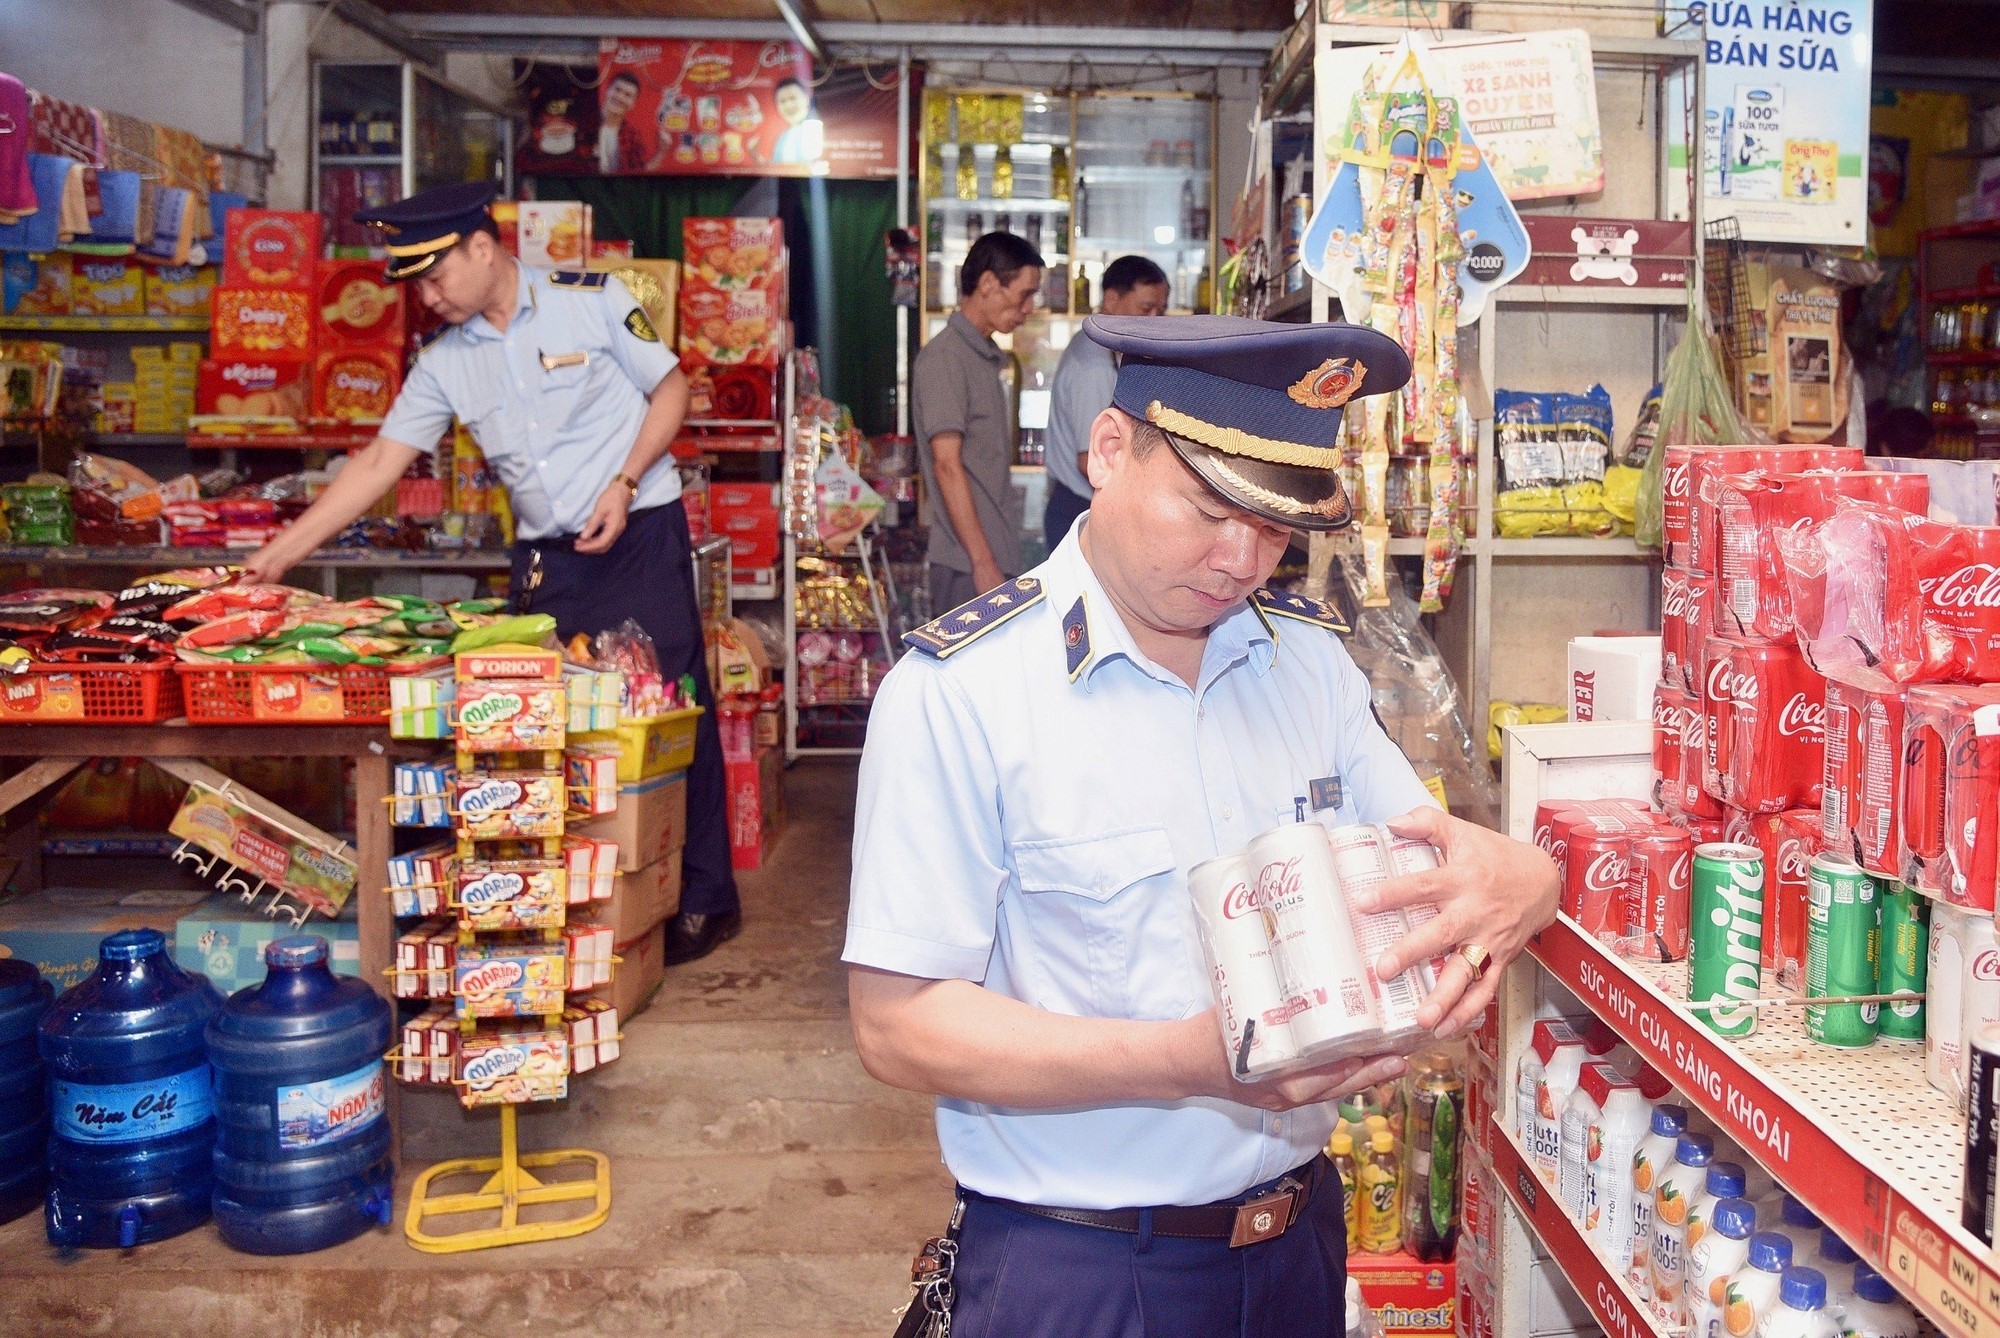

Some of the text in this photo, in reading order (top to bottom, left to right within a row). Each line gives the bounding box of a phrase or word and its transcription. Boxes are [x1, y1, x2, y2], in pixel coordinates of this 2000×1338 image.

[1763, 0, 1852, 35] HÀNG
[1706, 34, 1839, 72] BÁN SỮA
[486, 660, 541, 674] ORION
[1573, 670, 1596, 722] EER
[1274, 893, 1305, 912] plus
[1708, 859, 1763, 1035] Sprite
[1580, 960, 1791, 1163] SỨC HÚT CỦA SẢNG KHOÁI
[1952, 1257, 1975, 1286] NW
[1940, 1289, 1978, 1332] 00152
